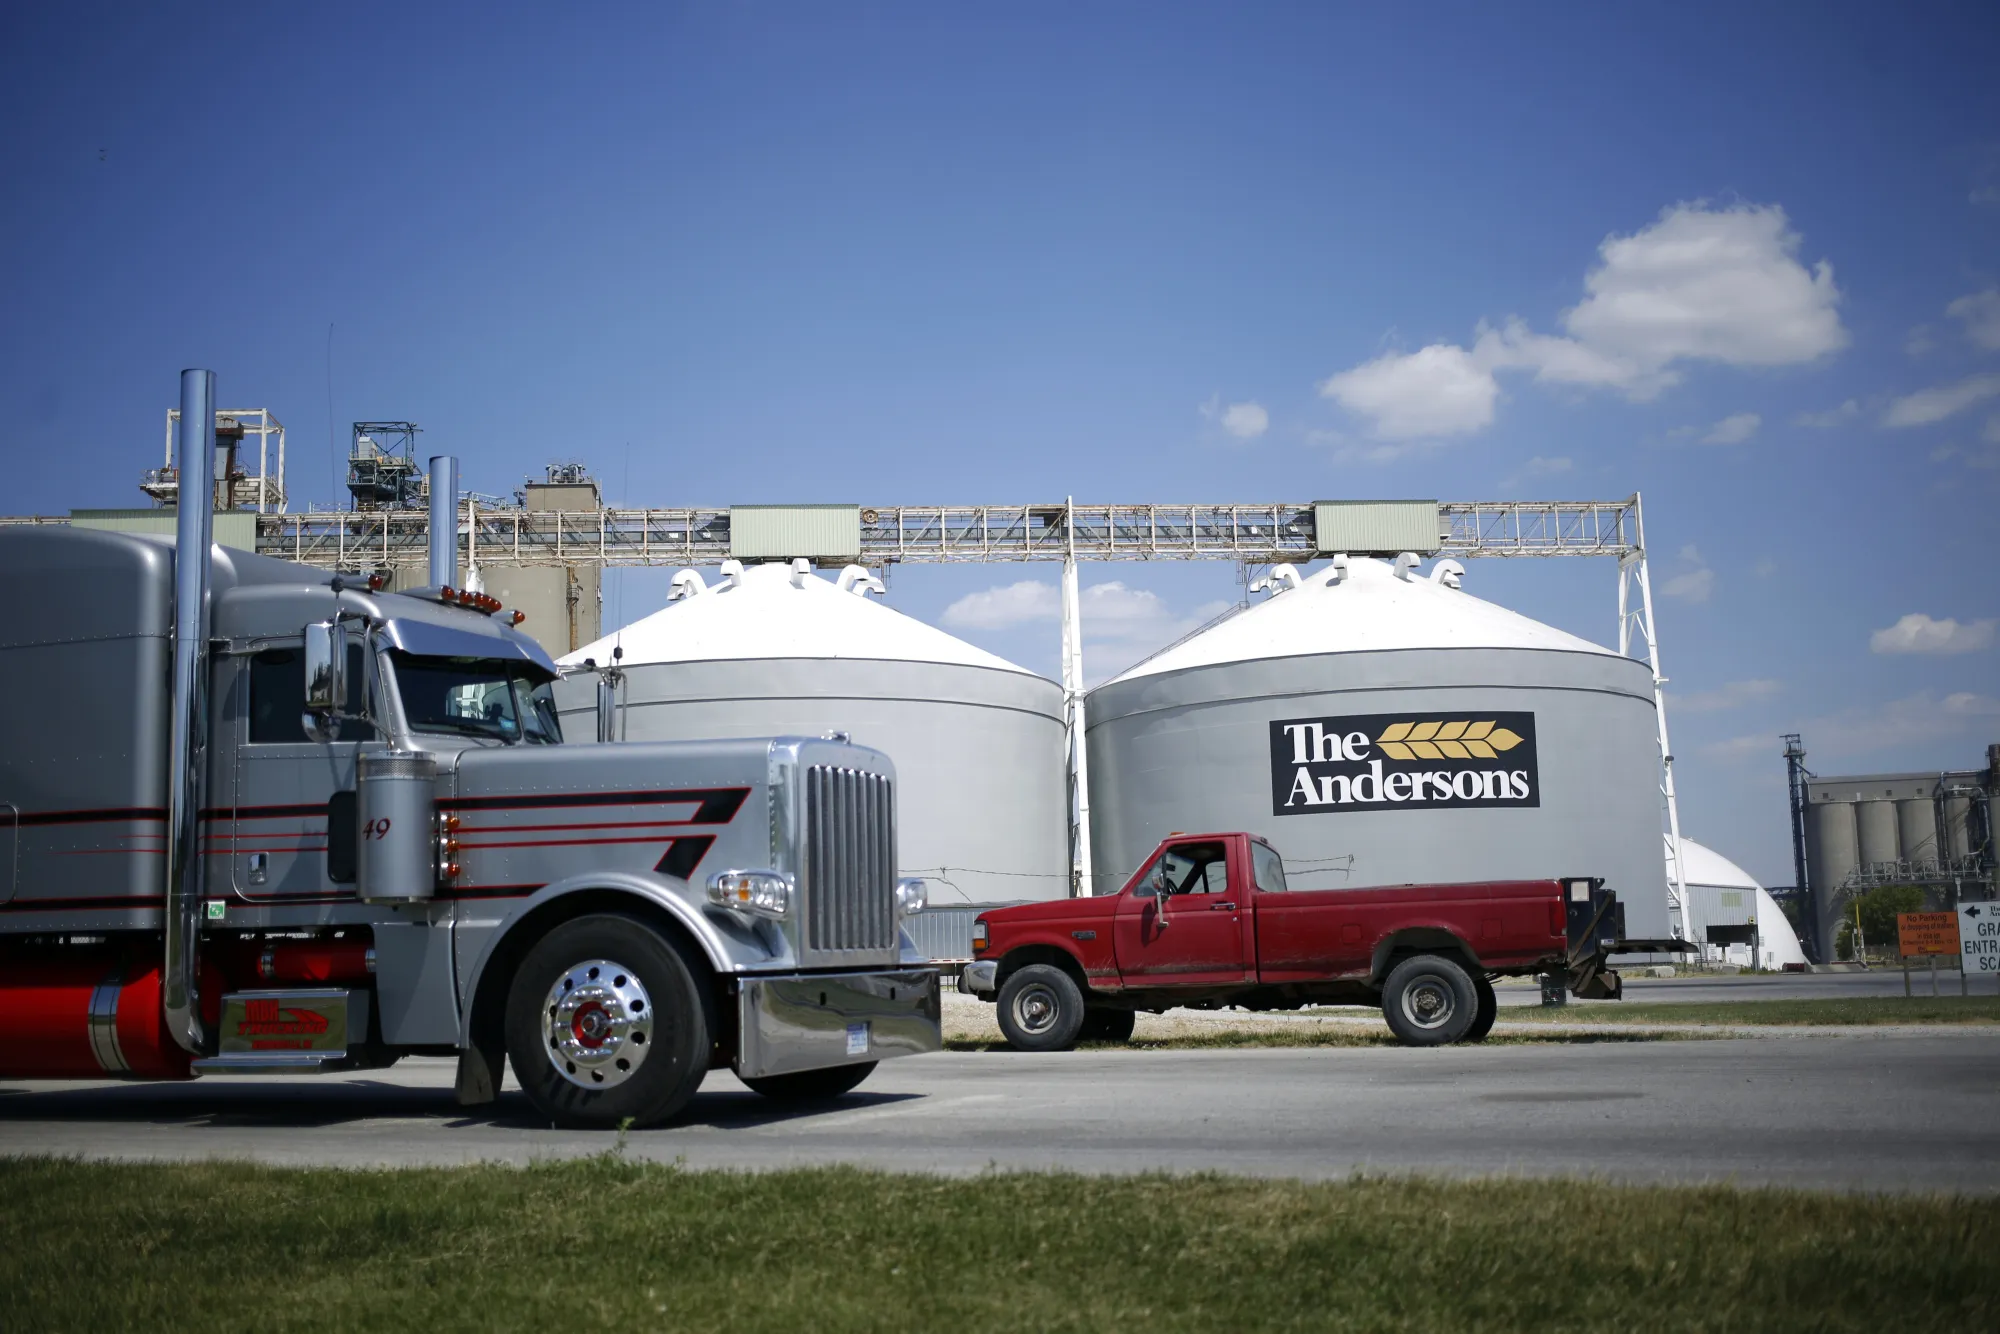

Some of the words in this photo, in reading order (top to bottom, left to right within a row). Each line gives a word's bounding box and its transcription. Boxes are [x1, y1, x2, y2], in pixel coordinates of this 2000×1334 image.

[1283, 722, 1370, 764] The
[1283, 759, 1530, 807] Andersons
[362, 817, 391, 841] 49
[1919, 914, 1947, 923] Parking
[1964, 940, 2000, 955] ENTR
[1979, 956, 2000, 971] SC
[237, 1021, 328, 1035] TRUCKING
